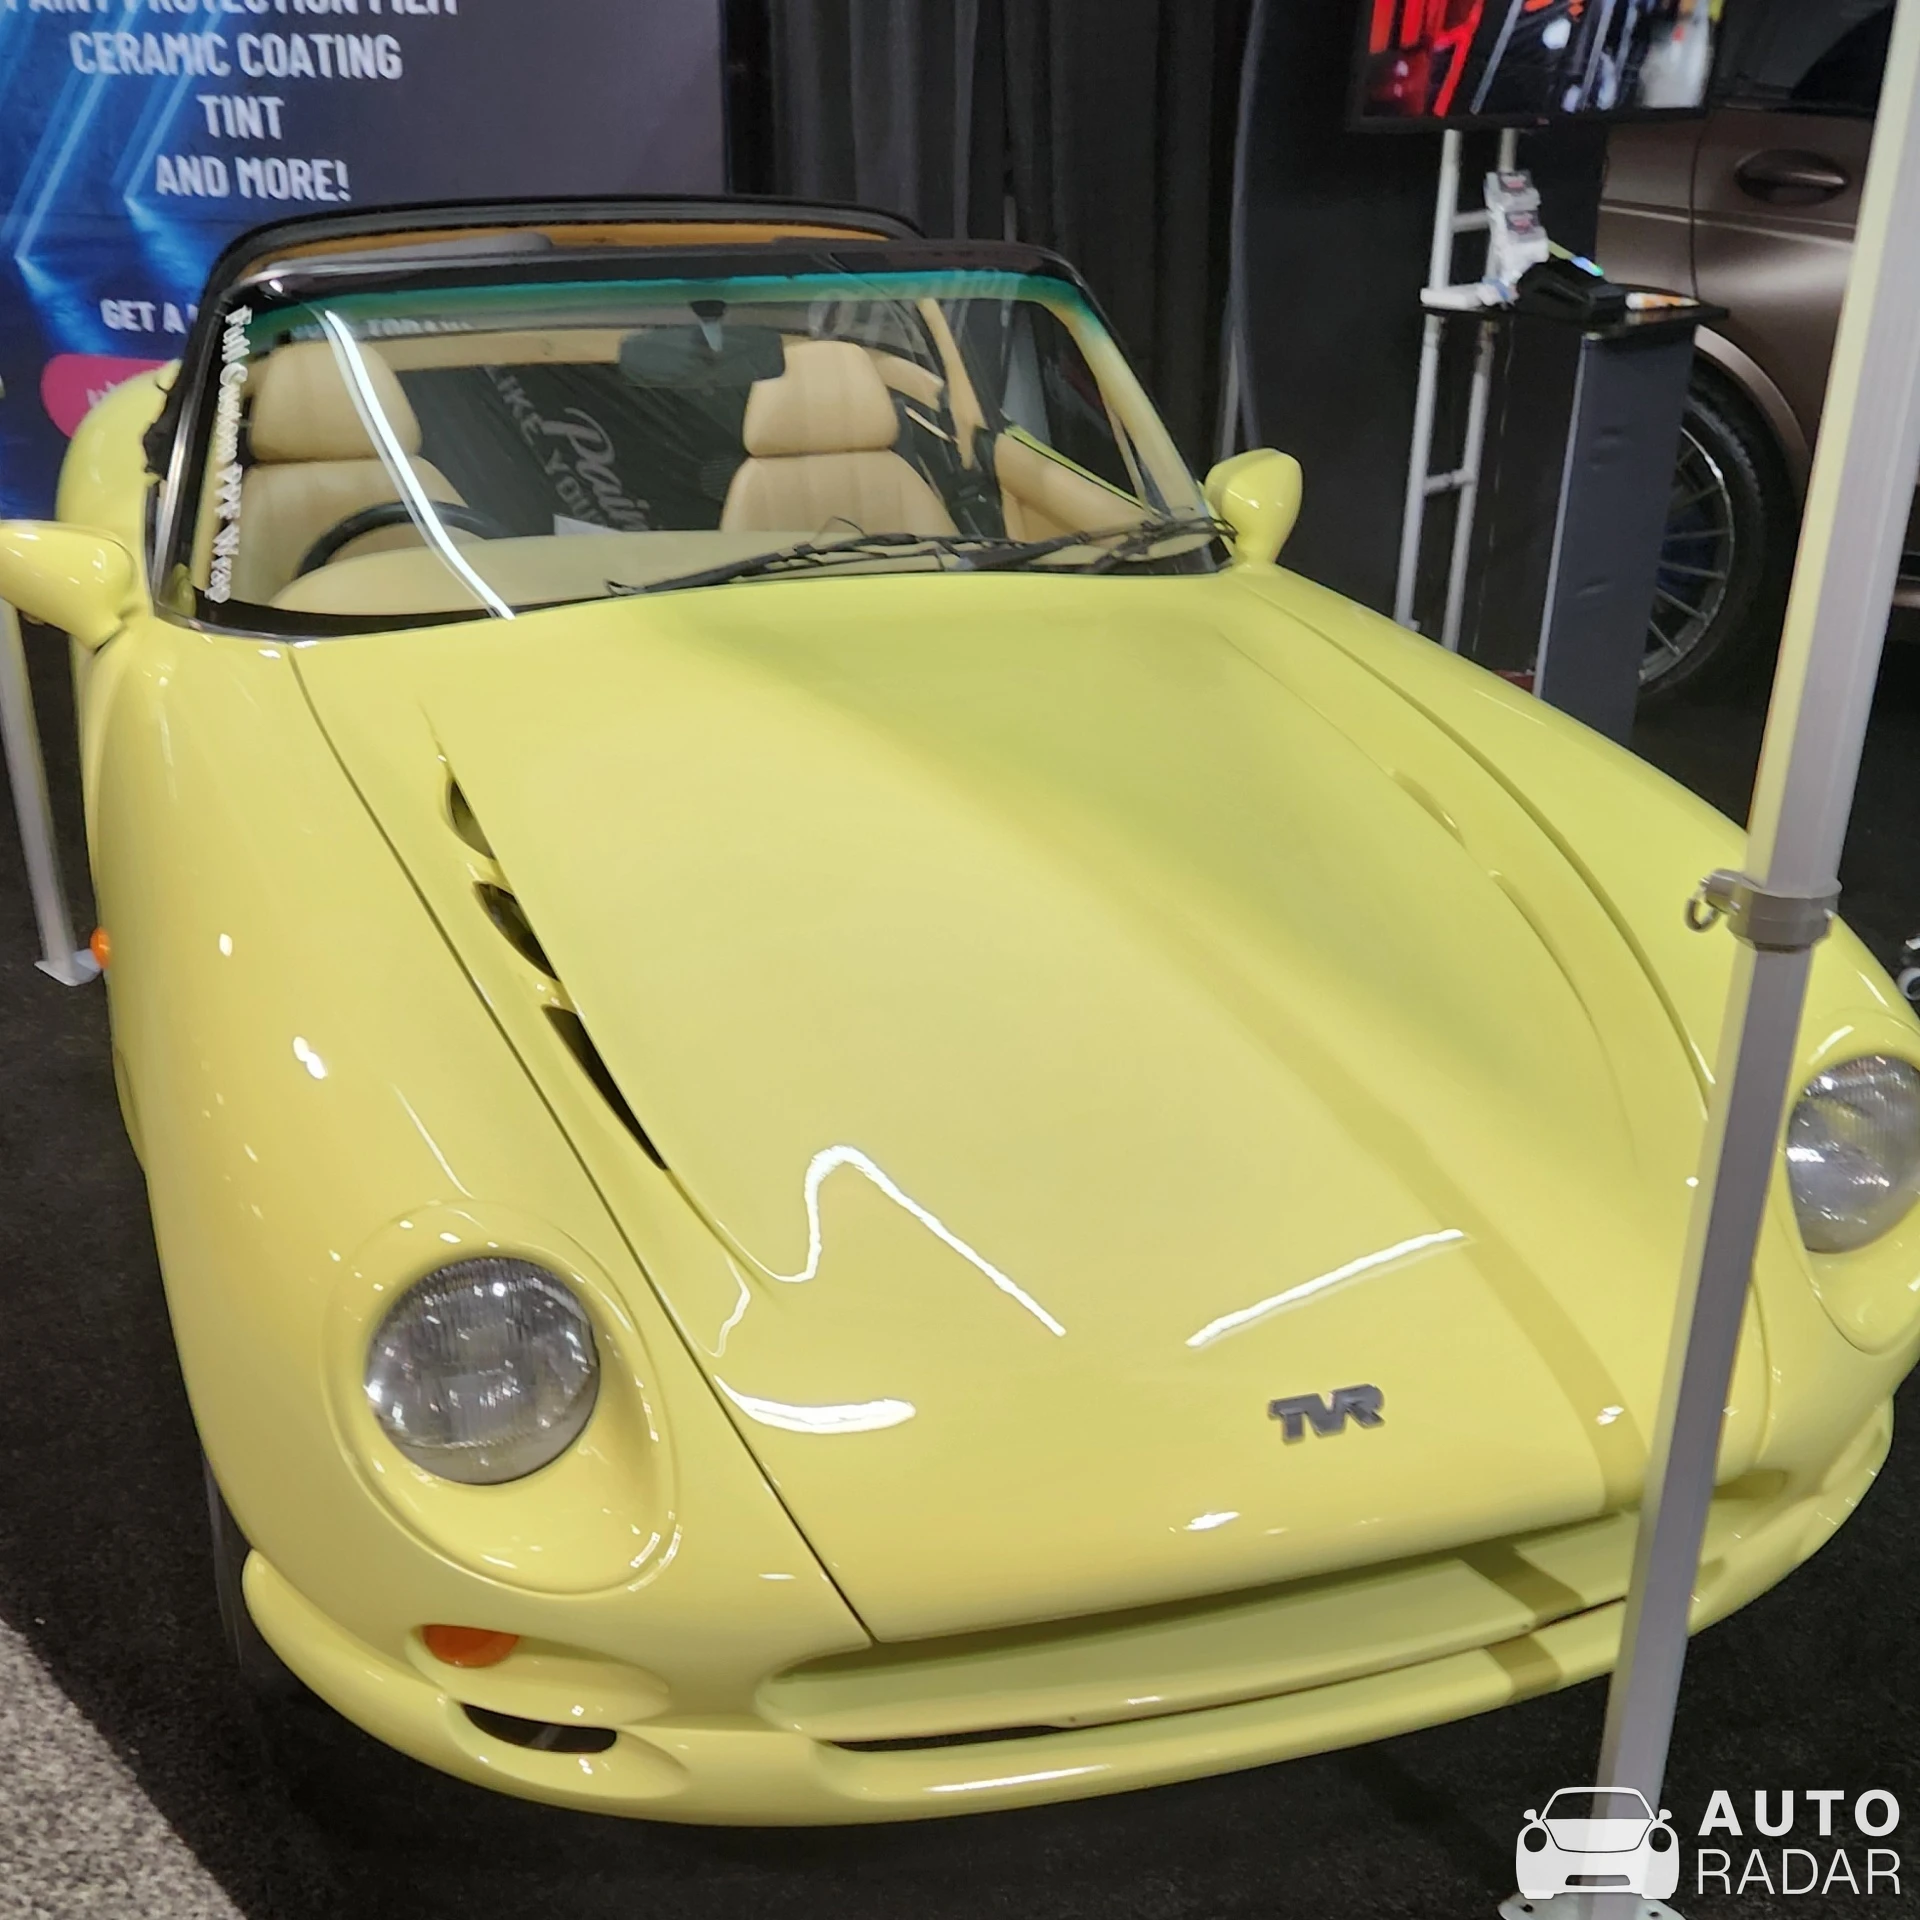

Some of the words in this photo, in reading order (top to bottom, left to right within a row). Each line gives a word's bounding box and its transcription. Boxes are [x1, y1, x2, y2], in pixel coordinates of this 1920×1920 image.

[69, 31, 231, 78] CERAMIC
[236, 32, 403, 80] COATING
[196, 94, 285, 140] TINT
[156, 154, 230, 198] AND
[234, 156, 351, 202] MORE!
[100, 299, 156, 332] GET
[163, 302, 187, 334] A
[222, 304, 253, 363] Full
[216, 362, 249, 464] Custom
[213, 461, 244, 520] PPF
[203, 521, 241, 603] Wrap
[1267, 1383, 1386, 1446] TVR
